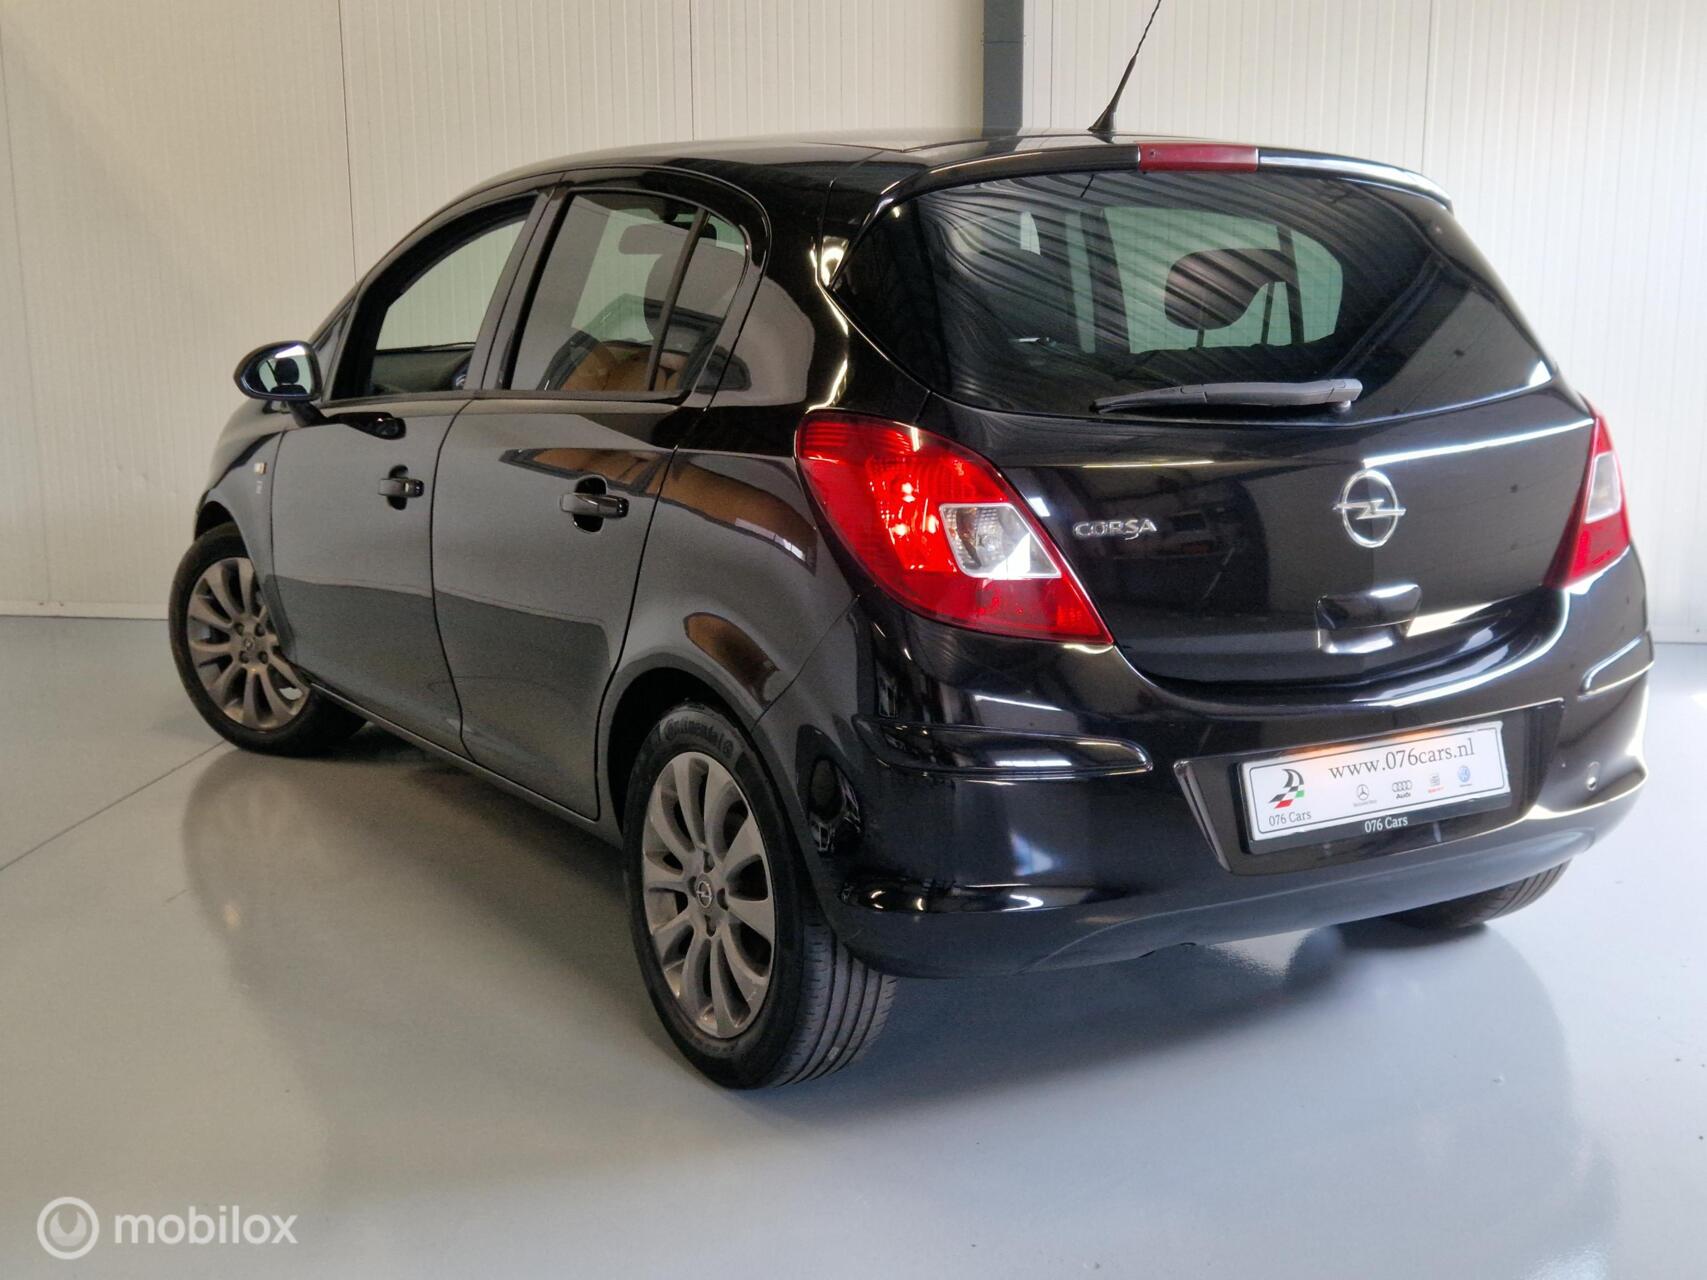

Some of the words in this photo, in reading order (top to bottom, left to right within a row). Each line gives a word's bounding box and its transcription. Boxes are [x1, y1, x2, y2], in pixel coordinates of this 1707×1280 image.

[1074, 518, 1158, 541] CORSA
[1328, 737, 1476, 780] www.076cars.nl
[1268, 814, 1287, 827] 076
[1288, 810, 1312, 824] Cars
[1364, 819, 1383, 833] 076
[1385, 816, 1409, 830] Cars
